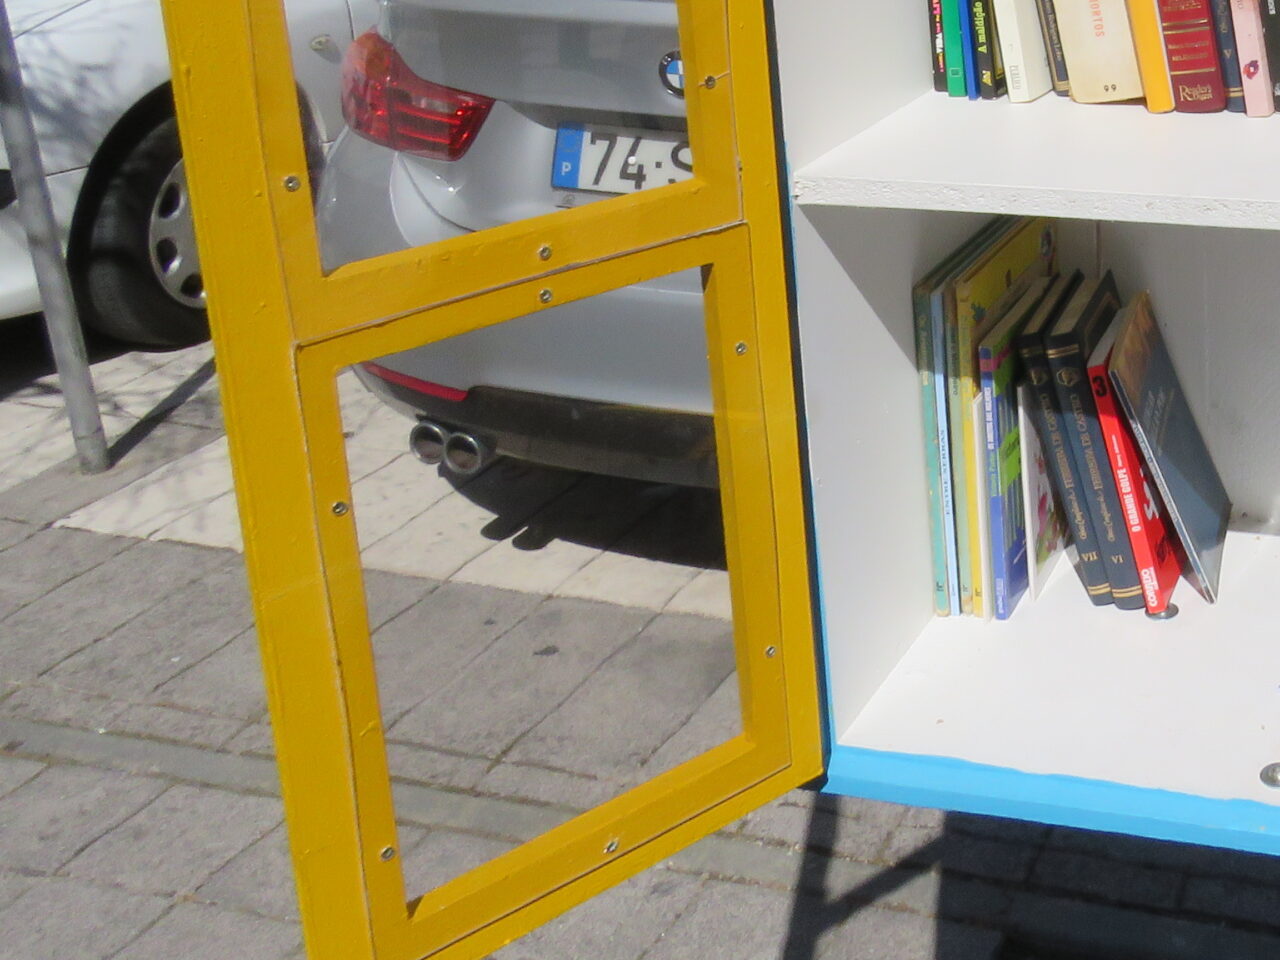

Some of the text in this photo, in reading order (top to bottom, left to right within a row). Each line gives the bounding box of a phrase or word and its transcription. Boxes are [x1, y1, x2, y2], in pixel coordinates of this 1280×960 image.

[973, 1, 987, 43] maldição
[978, 45, 987, 53] A
[561, 161, 573, 176] P
[1071, 393, 1087, 431] CASTRO
[1052, 432, 1063, 446] DE
[1080, 432, 1091, 446] DE
[1116, 468, 1132, 493] GOLPE
[1124, 494, 1140, 526] GRANDE
[1082, 551, 1098, 563] VII
[1112, 554, 1124, 565] VI
